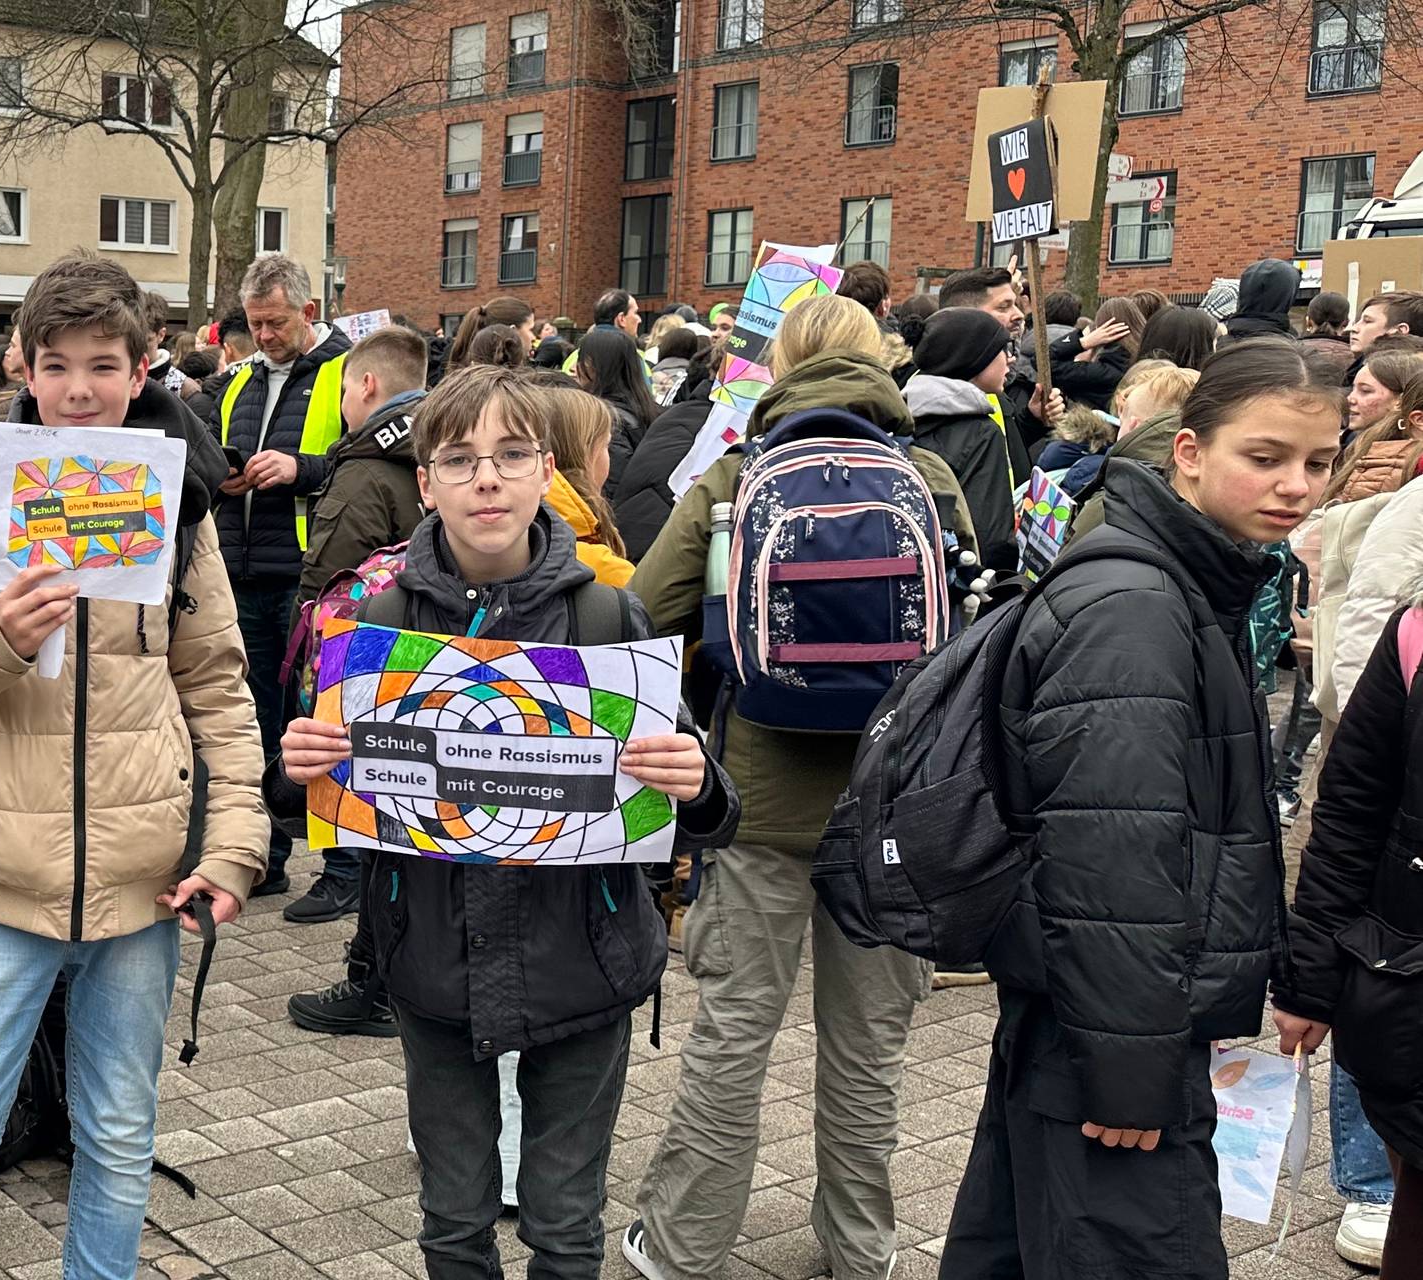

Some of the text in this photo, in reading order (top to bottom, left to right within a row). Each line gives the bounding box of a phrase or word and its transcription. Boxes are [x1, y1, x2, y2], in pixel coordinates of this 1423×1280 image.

[1000, 131, 1028, 163] WIR
[993, 203, 1051, 240] VIELFALT
[739, 310, 778, 330] ssismus
[30, 499, 139, 515] Schule ohne Rassismus
[33, 519, 125, 534] Schule mit Courage
[365, 734, 602, 764] Schule ohne Rassismus
[365, 768, 565, 799] Schule mit Courage
[886, 841, 894, 862] FILA
